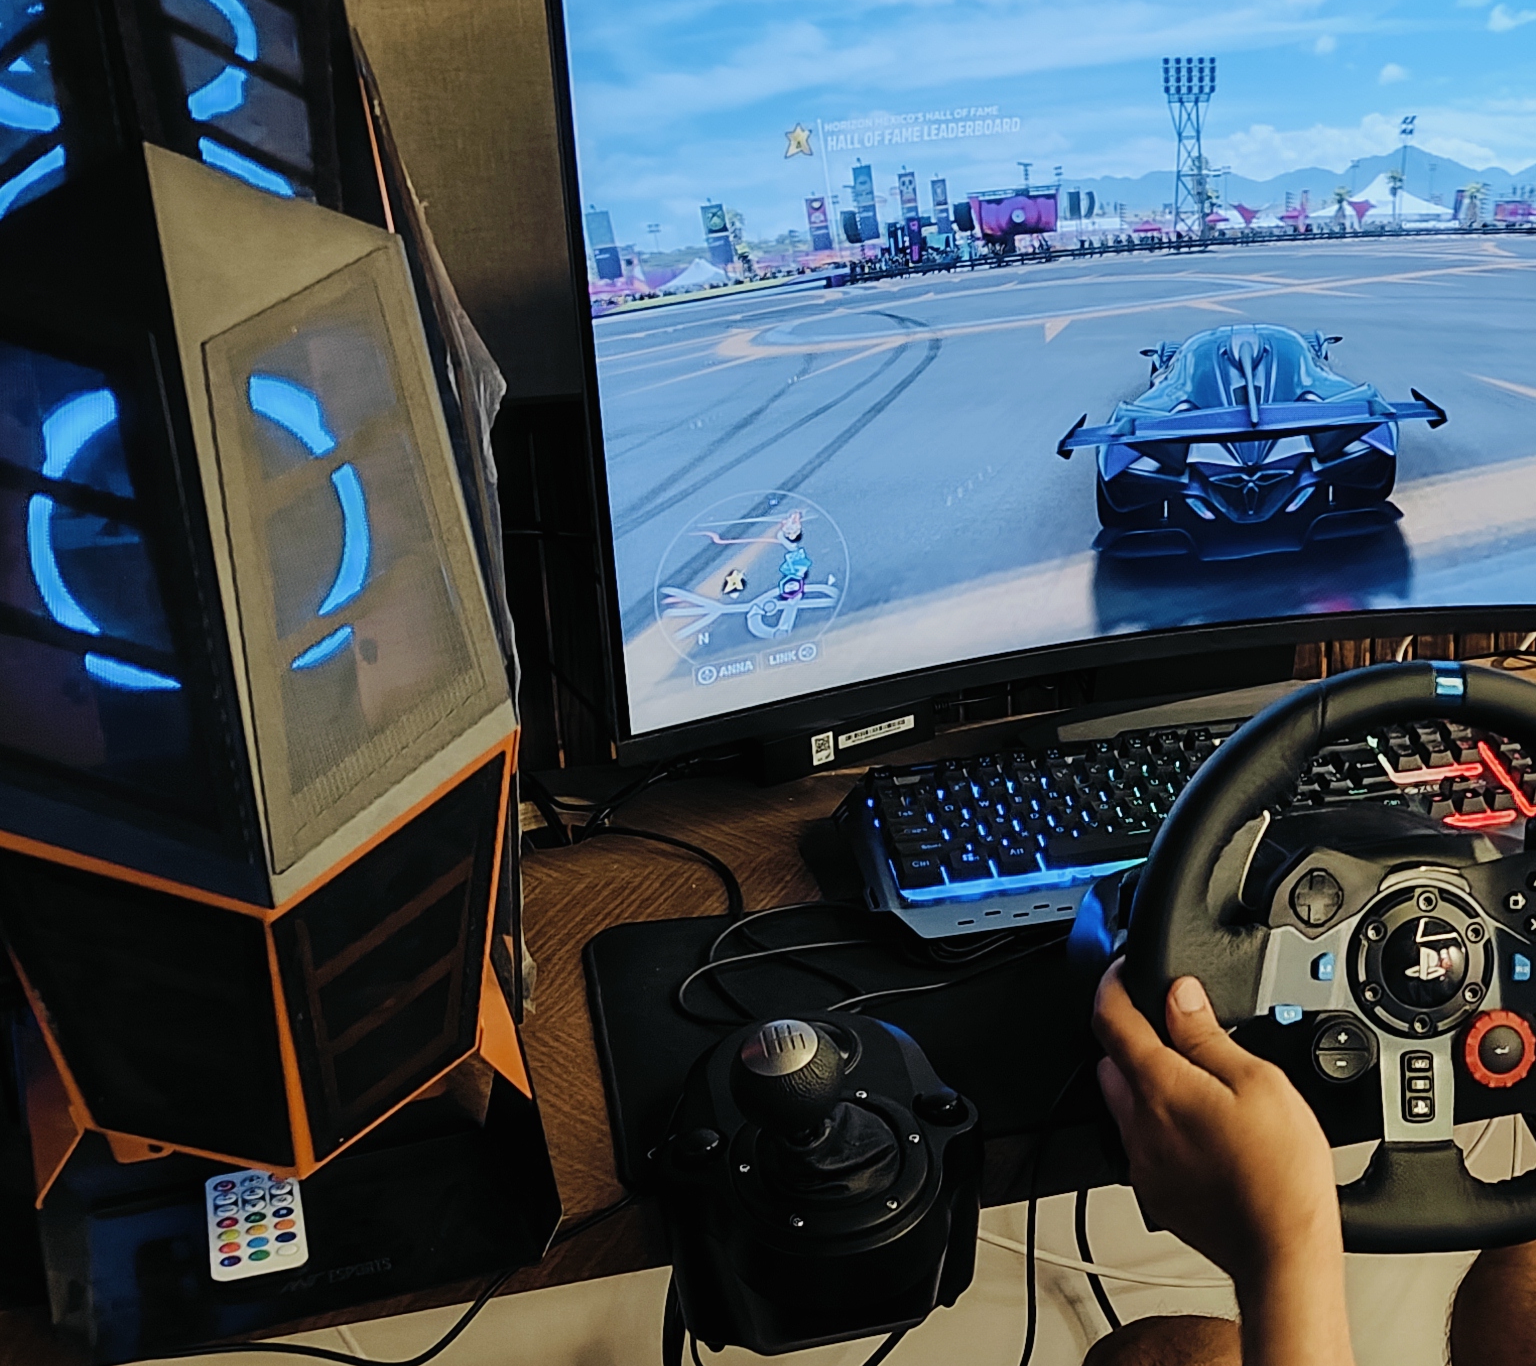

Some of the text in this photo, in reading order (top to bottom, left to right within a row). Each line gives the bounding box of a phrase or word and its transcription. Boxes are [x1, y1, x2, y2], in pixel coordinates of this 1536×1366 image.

[824, 105, 999, 133] HORIZON MEXICO'S HALL OF FAME
[827, 117, 1021, 152] HALL OF FAME LEADERBOARD
[698, 632, 709, 645] N
[769, 650, 796, 665] LINK
[718, 660, 753, 678] ANNA
[1009, 848, 1024, 856] Alt
[912, 860, 930, 868] Ctrl
